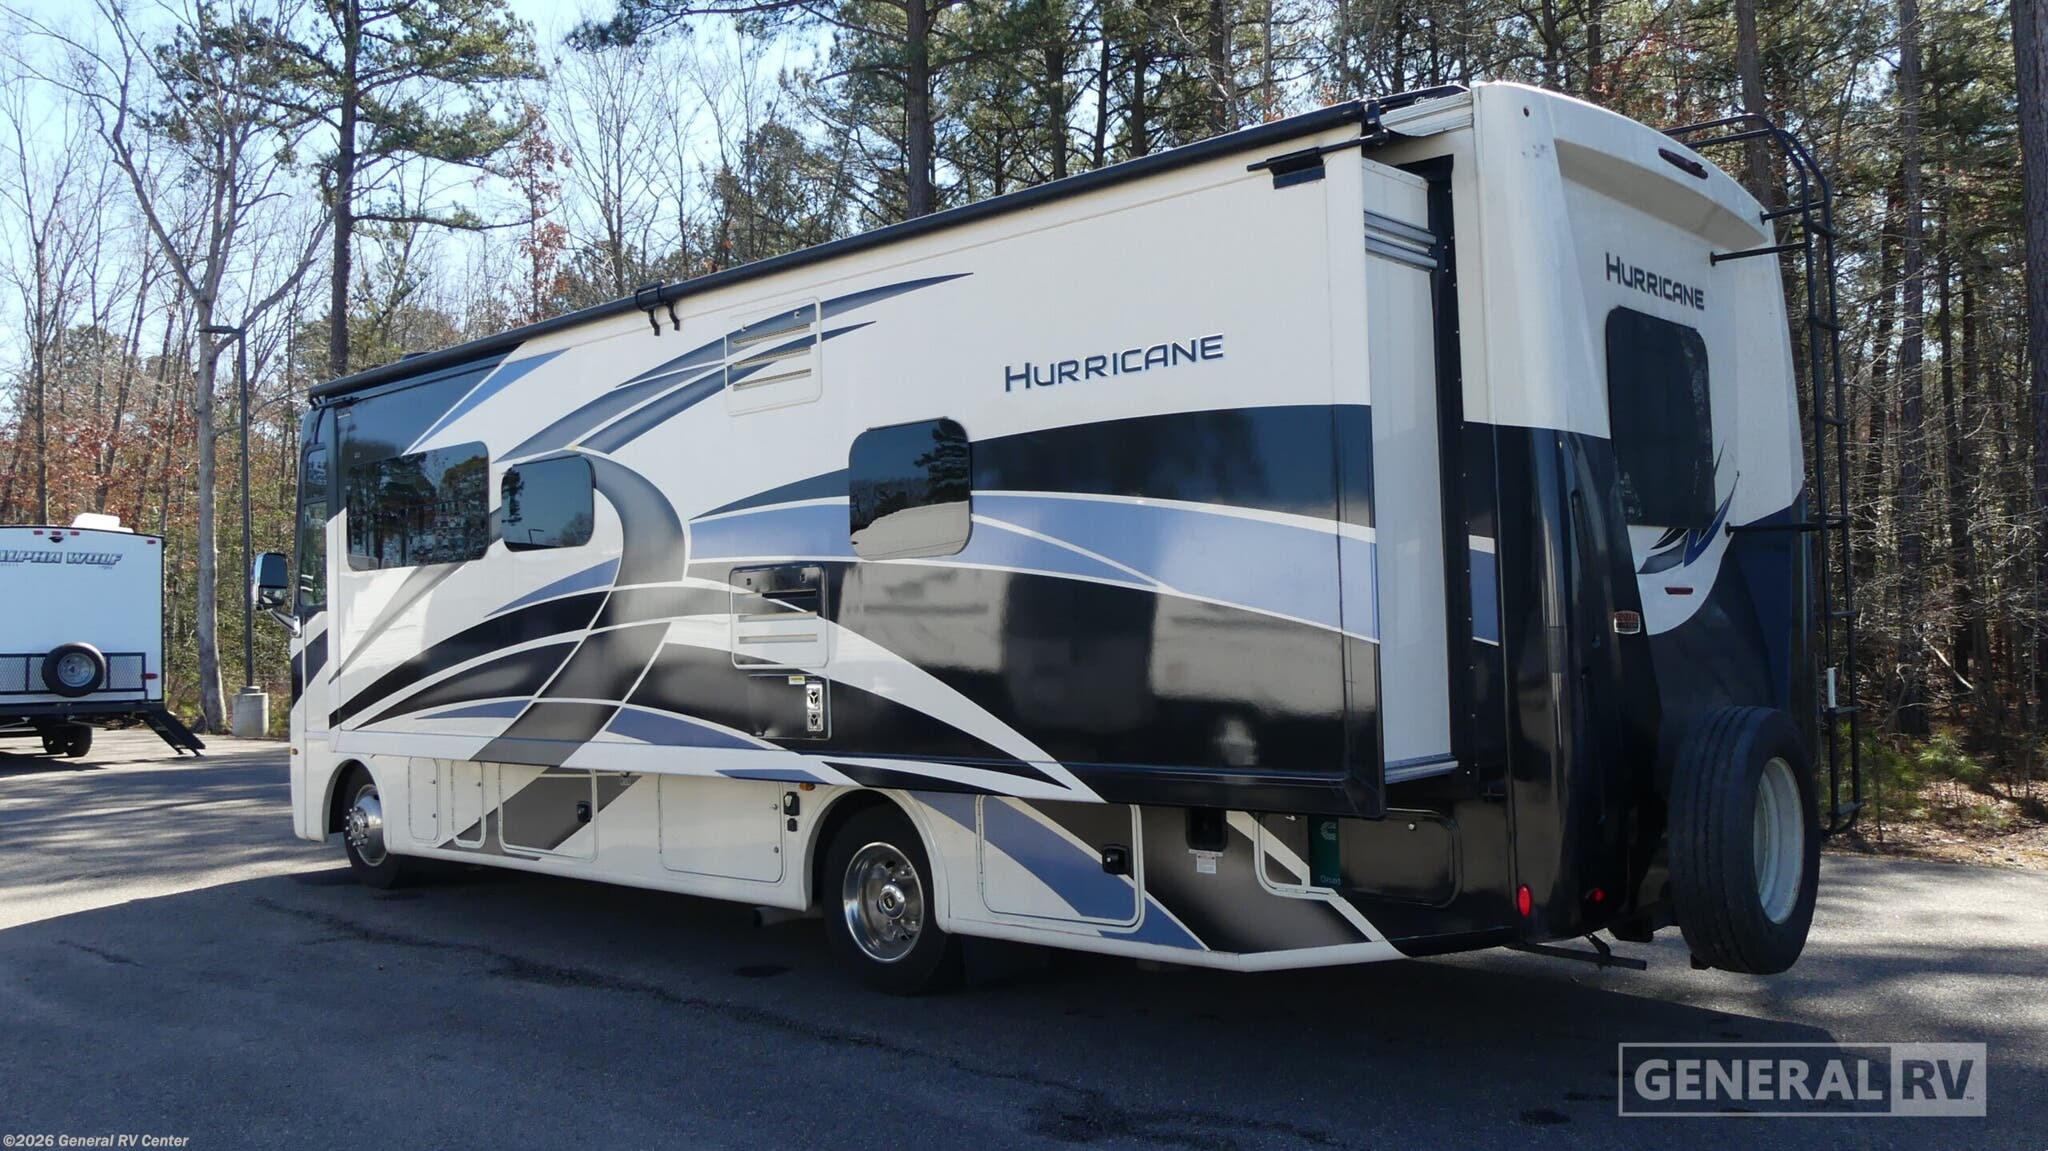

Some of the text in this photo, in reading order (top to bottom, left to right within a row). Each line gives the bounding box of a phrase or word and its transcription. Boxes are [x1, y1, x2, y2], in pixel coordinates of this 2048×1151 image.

[1606, 252, 1704, 311] HURRICANE
[1005, 334, 1223, 392] HURRICANE
[66, 552, 122, 565] WOLF
